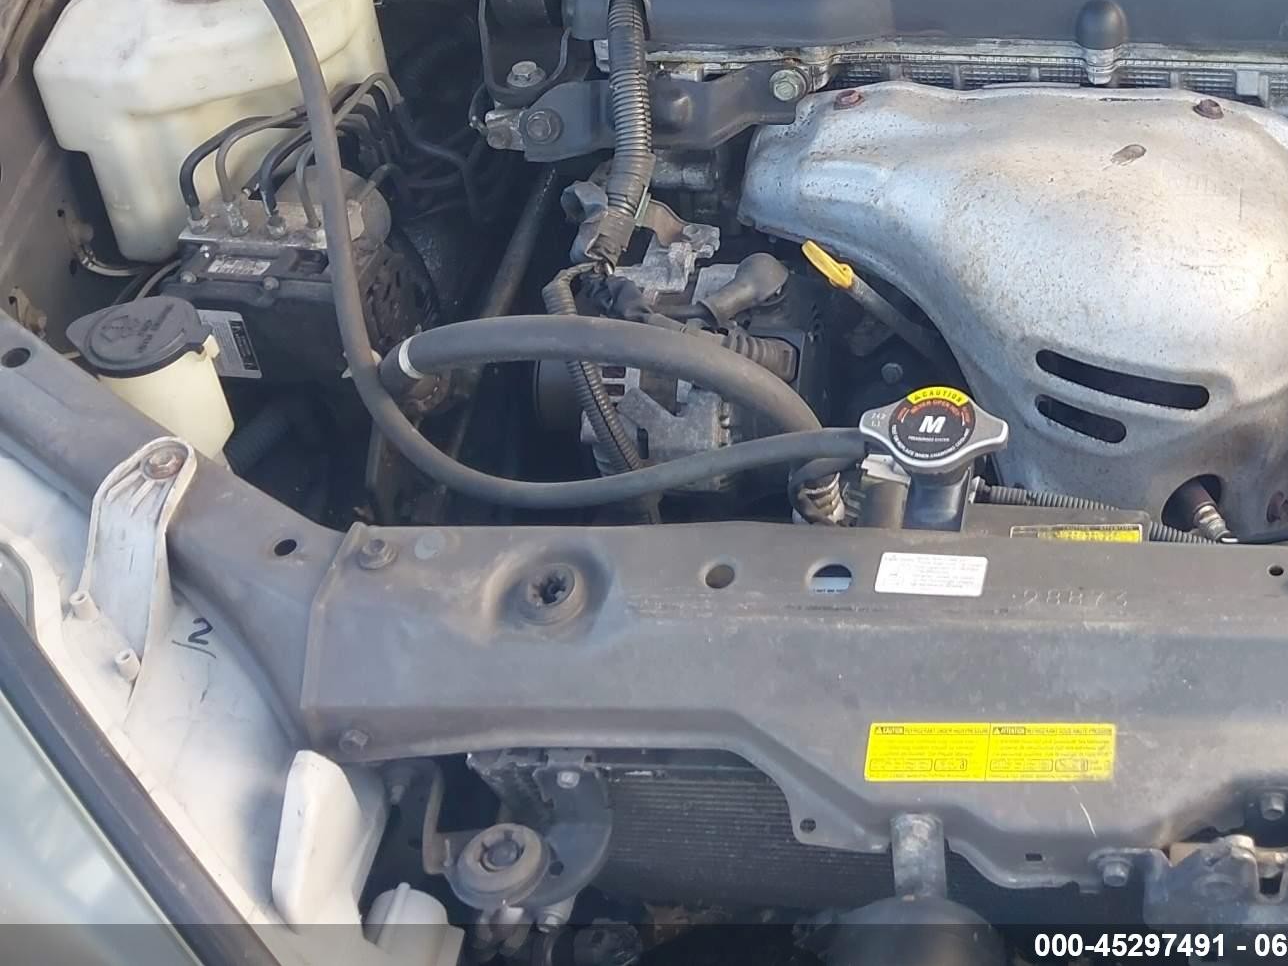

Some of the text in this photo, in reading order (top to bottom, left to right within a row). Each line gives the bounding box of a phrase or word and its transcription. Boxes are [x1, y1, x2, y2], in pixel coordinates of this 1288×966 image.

[923, 389, 963, 403] CAUTION
[918, 415, 946, 434] M
[188, 617, 213, 645] 2
